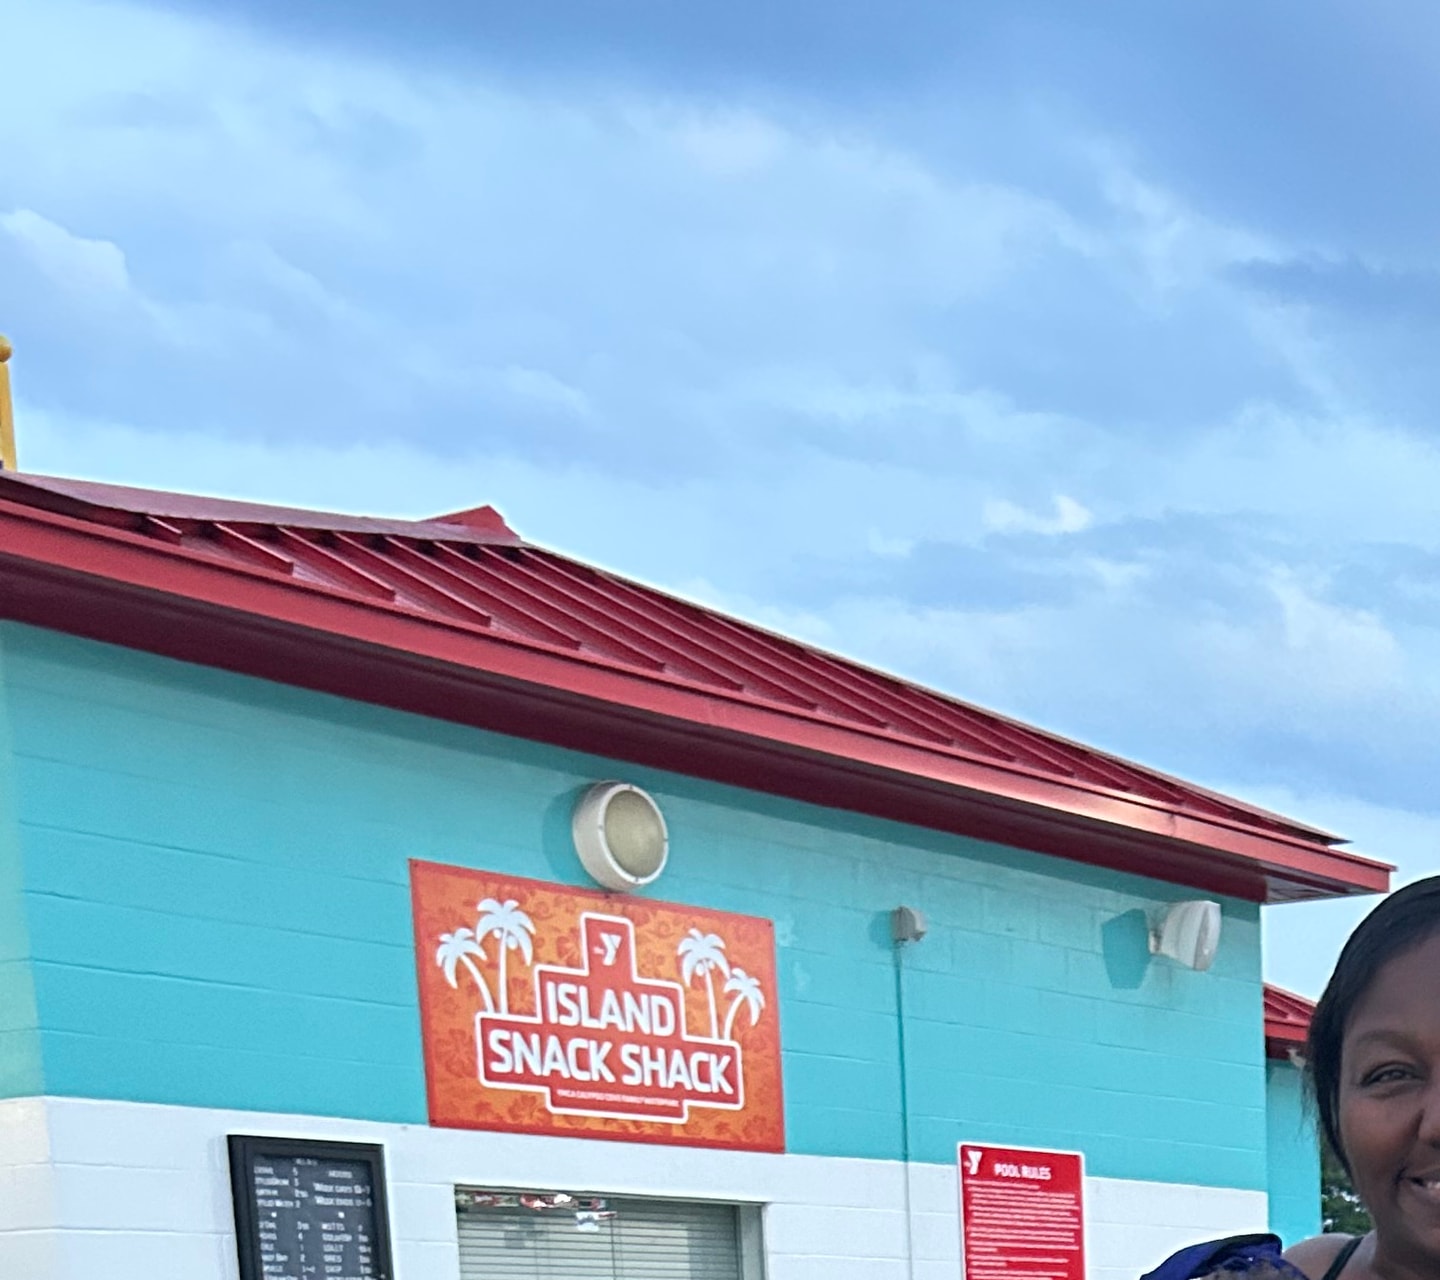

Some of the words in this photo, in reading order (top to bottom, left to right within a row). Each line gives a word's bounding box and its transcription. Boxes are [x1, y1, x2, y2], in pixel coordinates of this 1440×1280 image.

[545, 981, 676, 1037] ISLAND
[488, 1028, 616, 1083] SNACK
[620, 1042, 735, 1095] SHACK
[993, 1162, 1020, 1178] POOL
[1021, 1165, 1052, 1180] RULES
